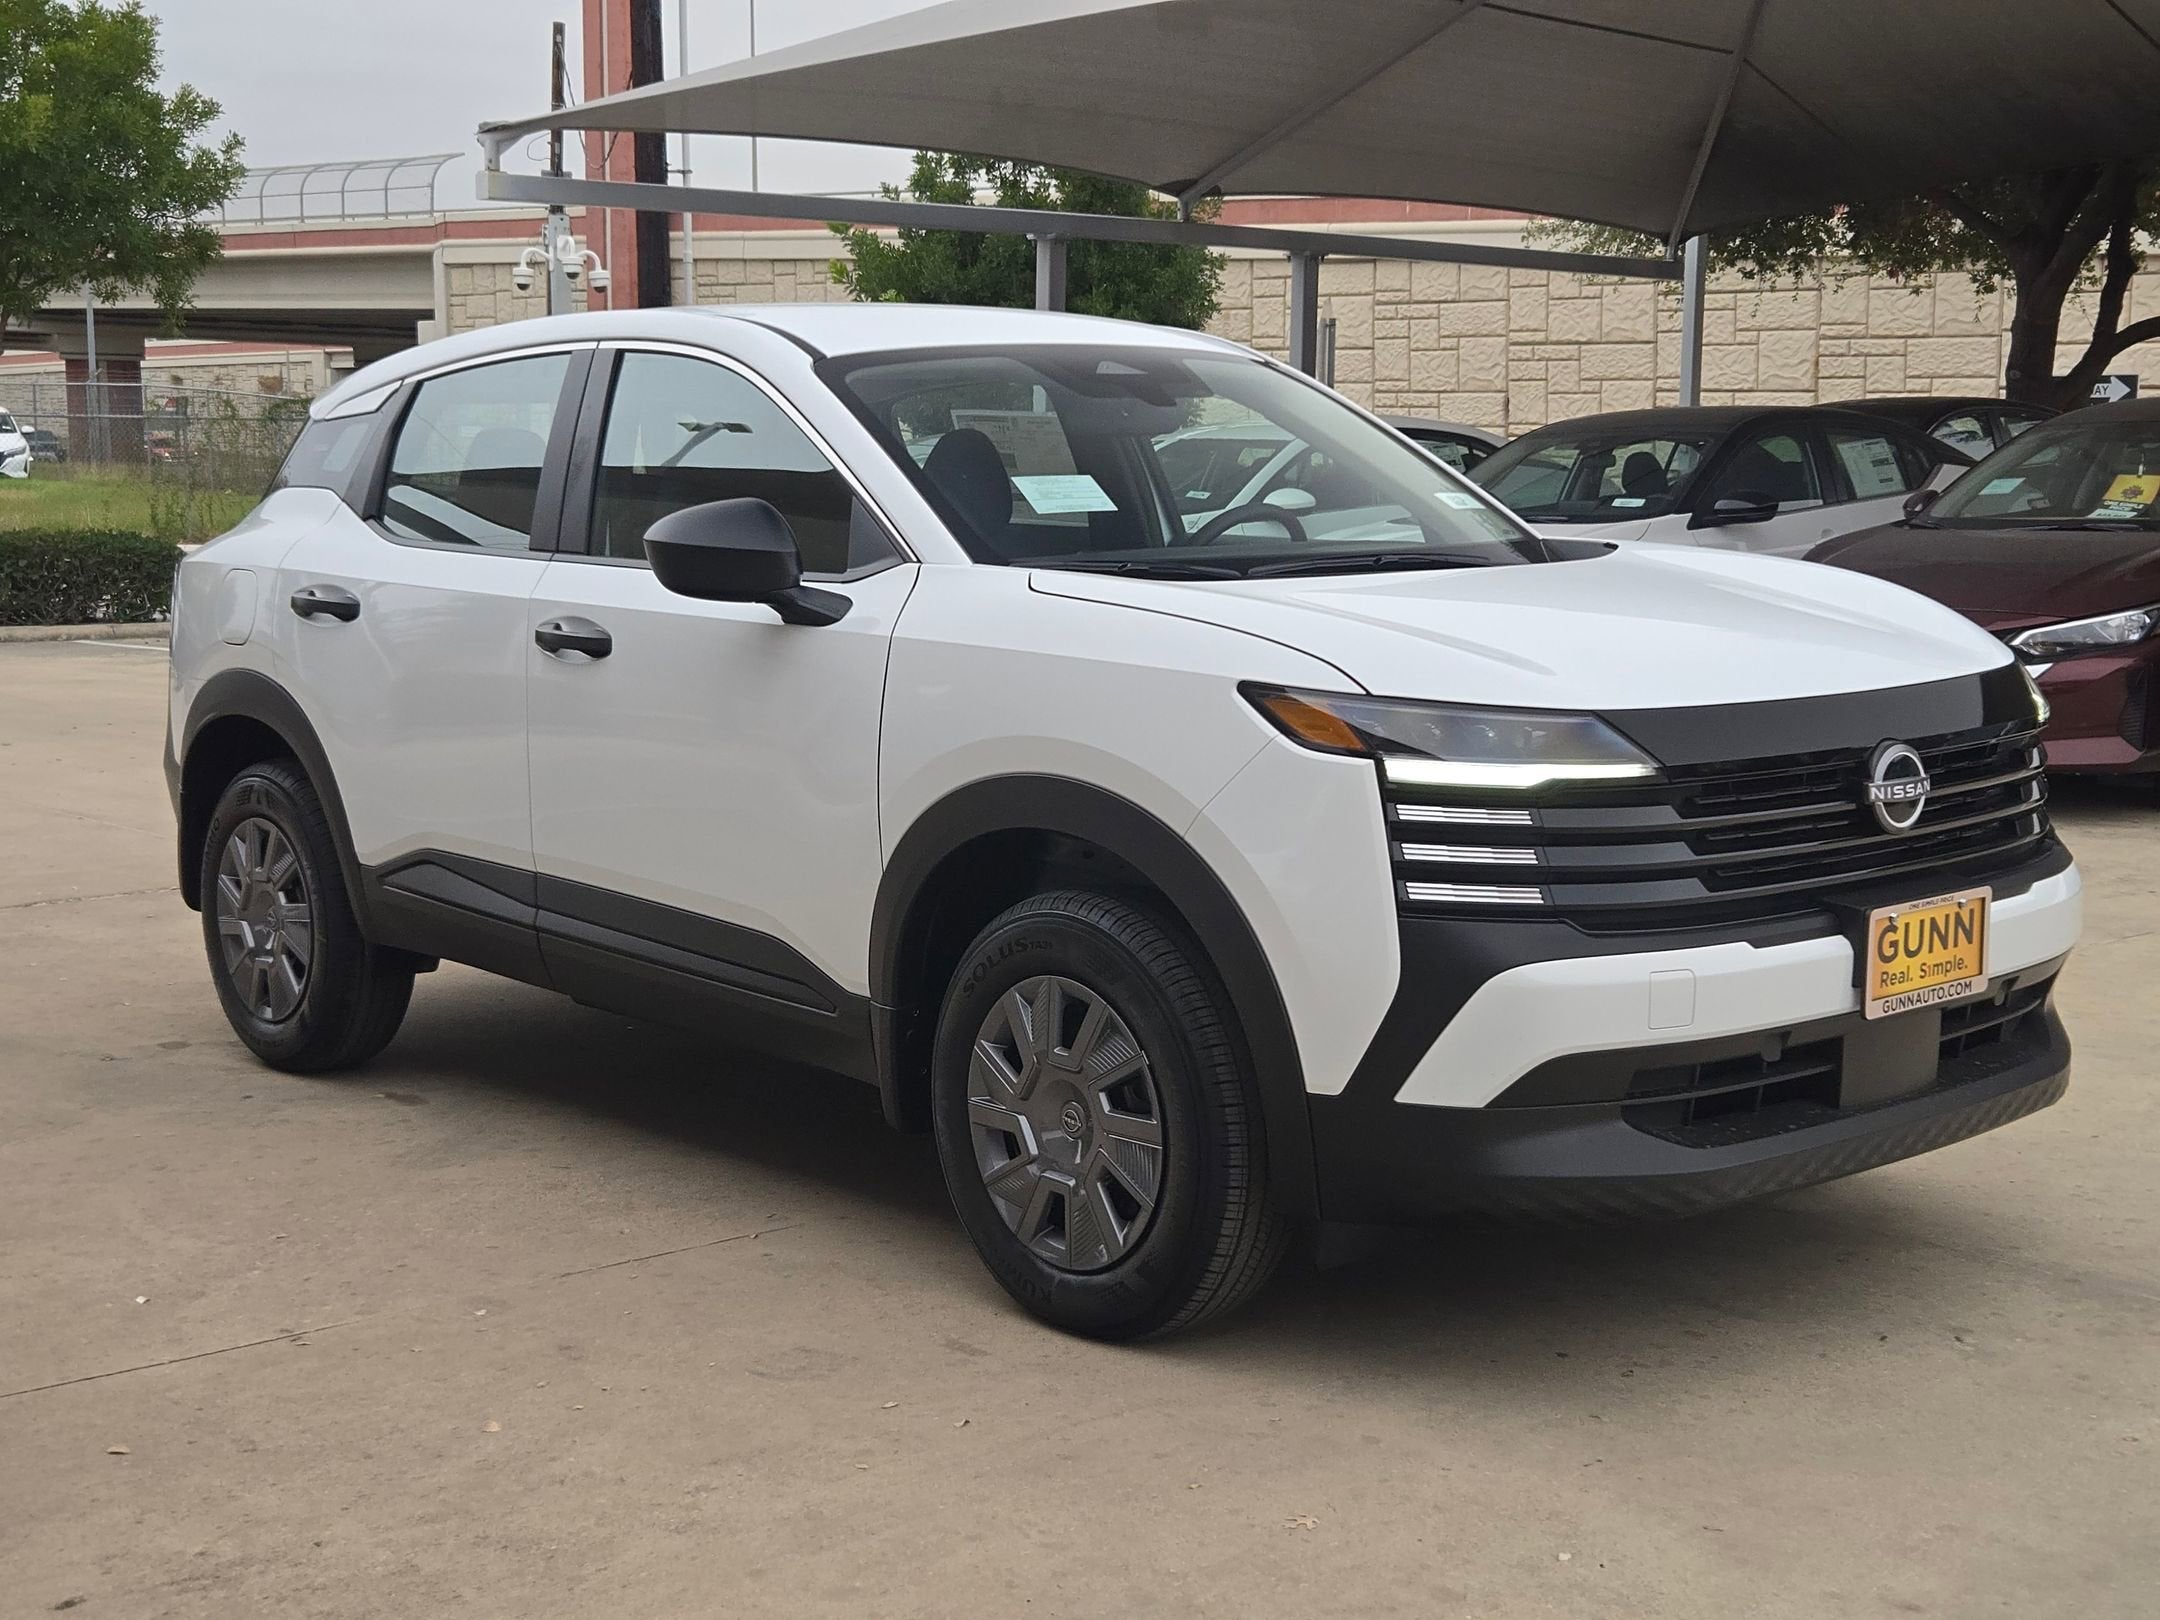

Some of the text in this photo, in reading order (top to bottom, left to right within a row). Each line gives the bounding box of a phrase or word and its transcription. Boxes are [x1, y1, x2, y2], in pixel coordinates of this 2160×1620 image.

[1871, 779, 1930, 800] NISSAN
[1878, 908, 1975, 964] GUNN
[962, 936, 1029, 998] SOLUS
[1880, 965, 1913, 988] Real.
[1882, 980, 1973, 1014] GUNNAUTO.COM
